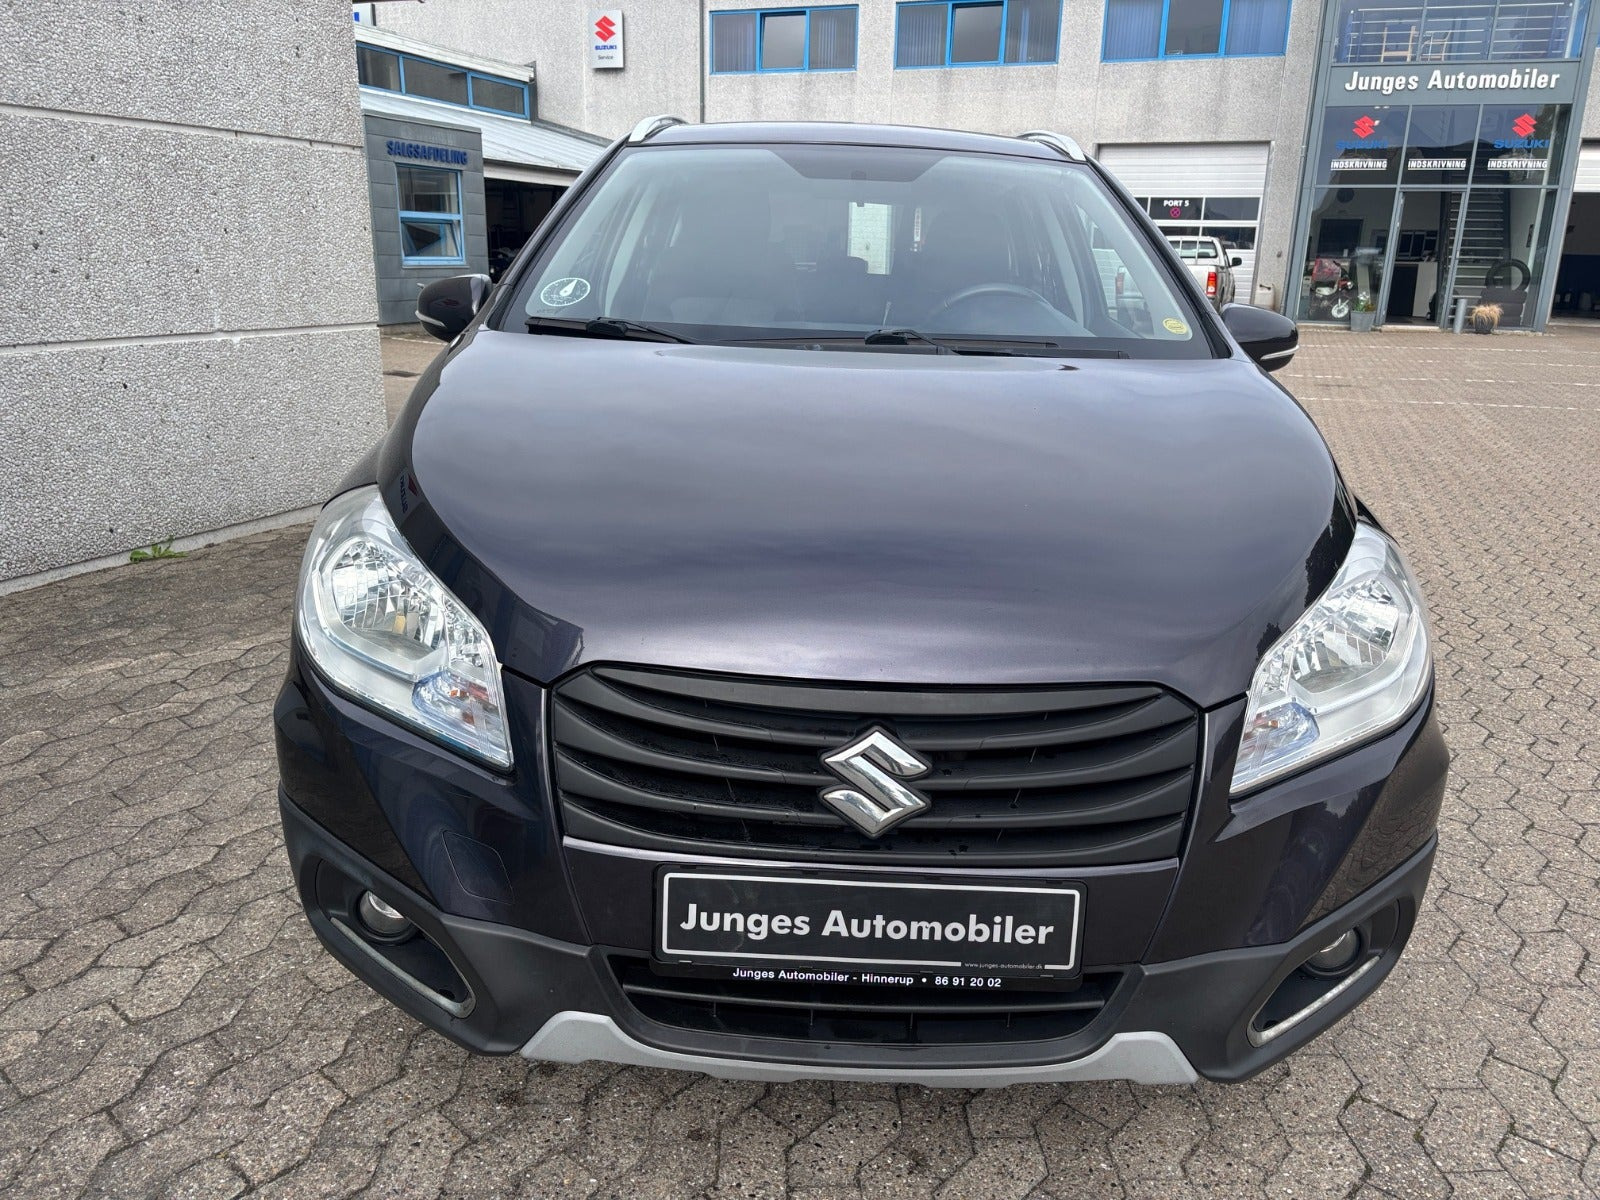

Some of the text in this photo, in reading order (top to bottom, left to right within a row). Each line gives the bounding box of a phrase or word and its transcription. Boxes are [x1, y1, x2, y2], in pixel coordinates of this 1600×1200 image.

[1344, 68, 1560, 95] Junges Automobiler
[1493, 139, 1550, 149] SUZUKI
[1330, 160, 1388, 169] INDSKRIVNING
[1407, 160, 1467, 169] INDSKRIVNING
[1487, 160, 1548, 169] INDSKRIVNING
[680, 903, 1055, 945] Junges Automobiler
[733, 968, 775, 980] Junges
[778, 969, 849, 982] Automobiler
[861, 973, 914, 986] Hinnerup
[934, 976, 949, 986] 86
[952, 977, 965, 986] 91
[970, 977, 984, 987] 20
[987, 978, 1001, 987] 02
